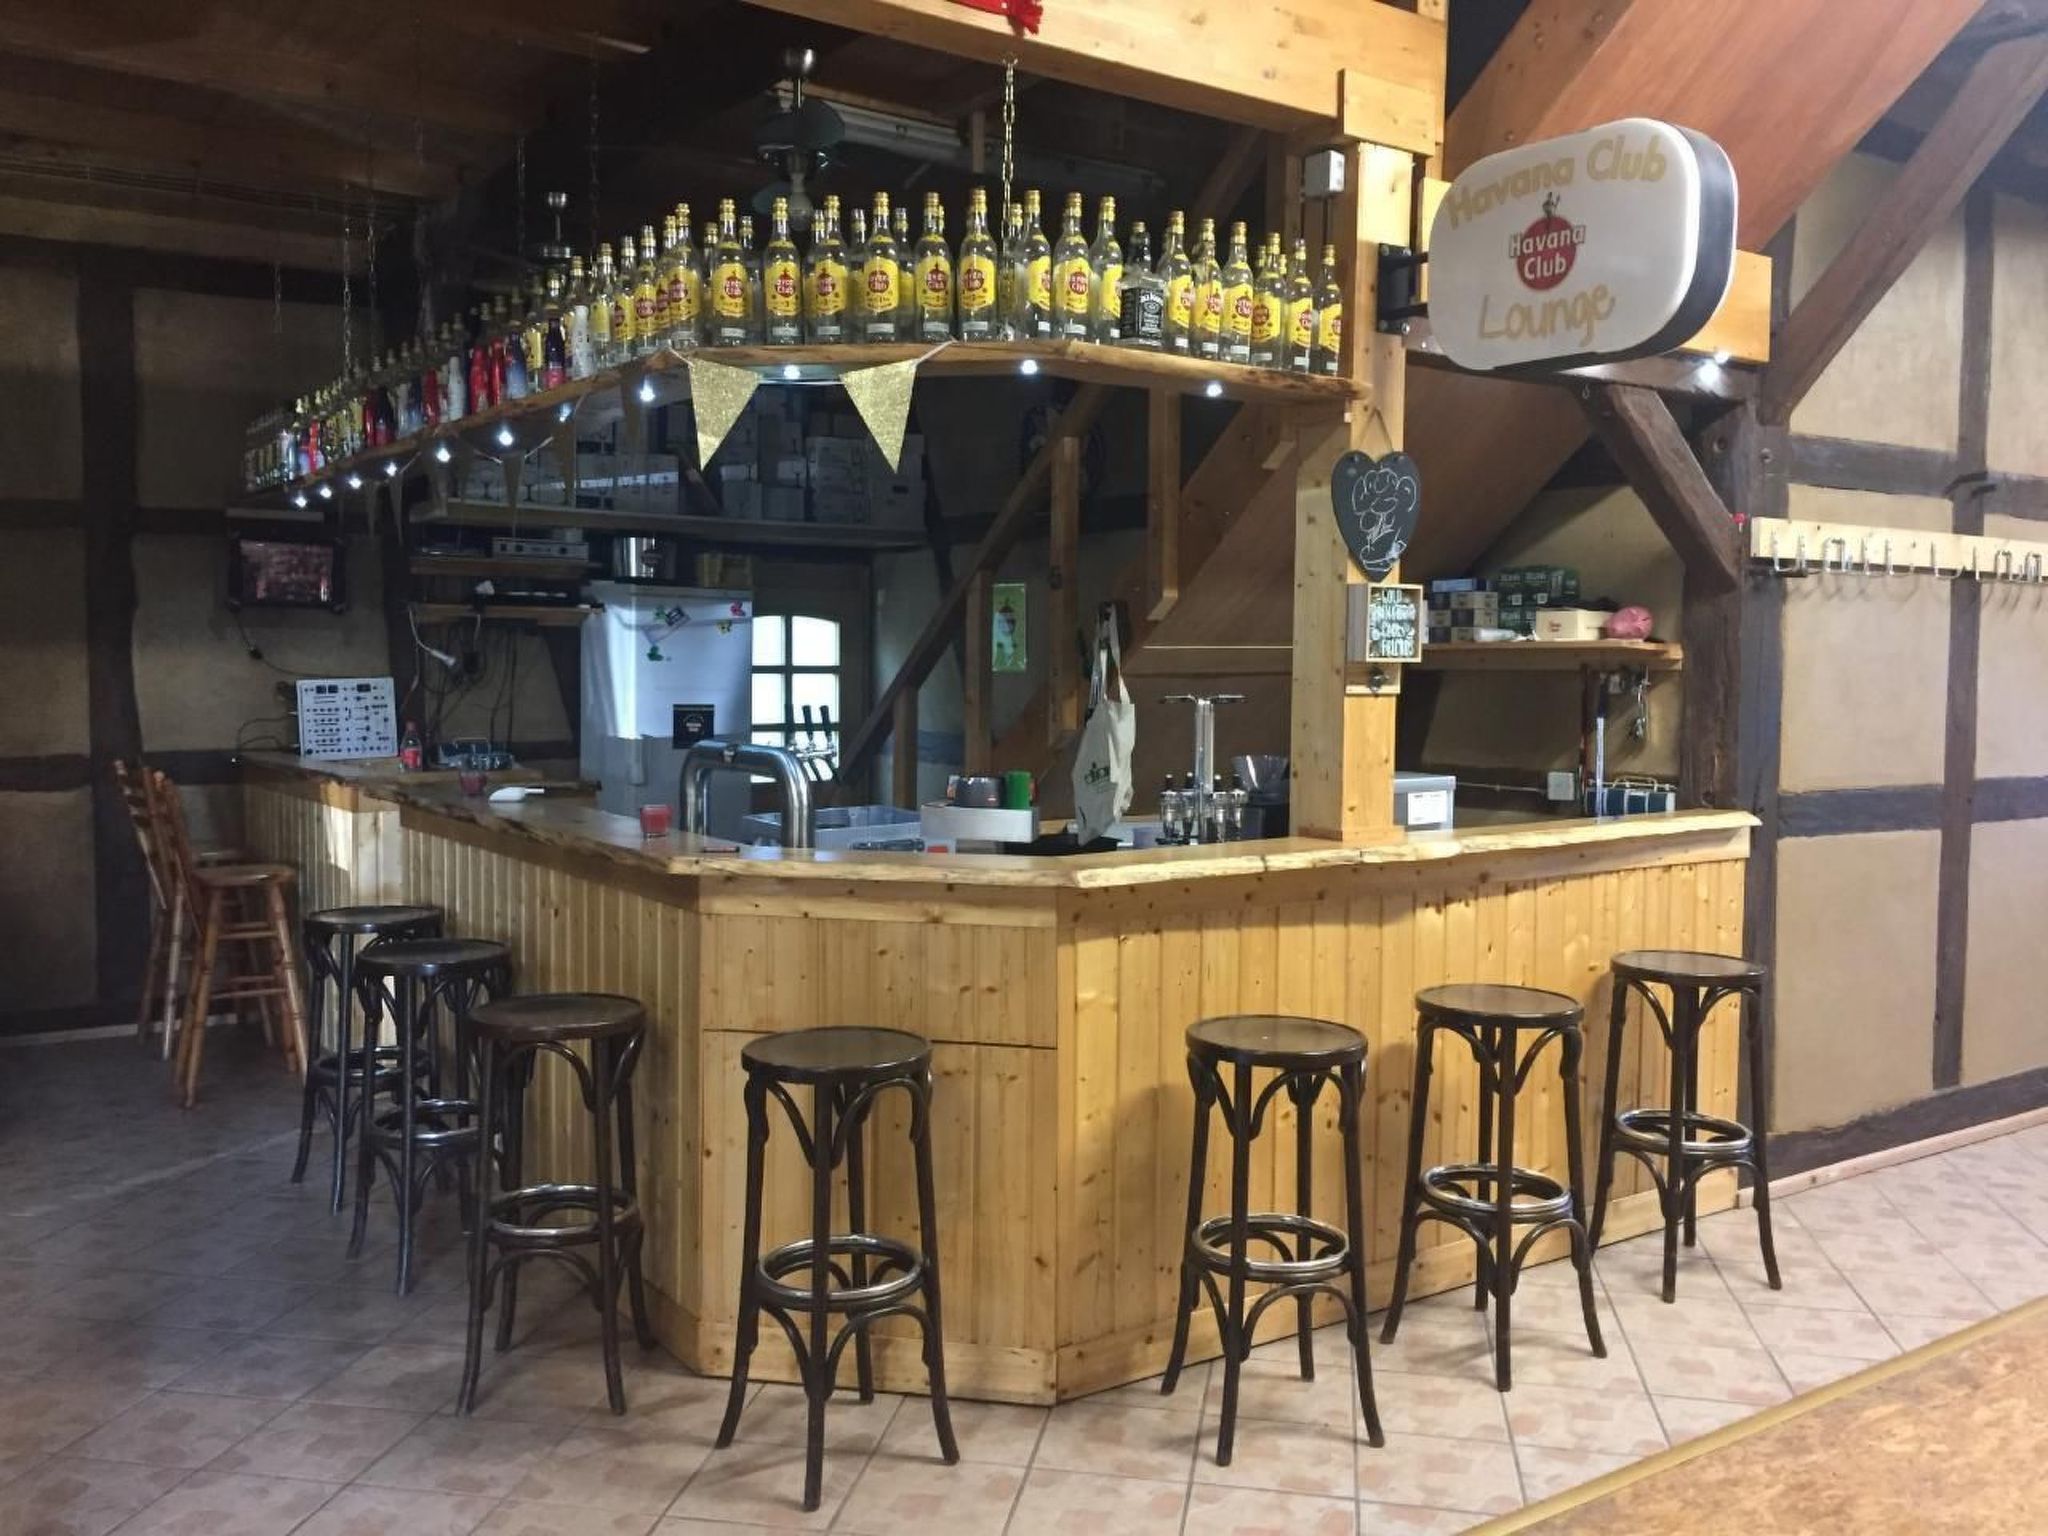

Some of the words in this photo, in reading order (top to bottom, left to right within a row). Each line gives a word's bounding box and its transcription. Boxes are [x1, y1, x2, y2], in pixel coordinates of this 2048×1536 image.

[1447, 157, 1575, 229] Havana
[1587, 133, 1666, 182] Club
[1508, 225, 1586, 258] Havana
[1523, 252, 1567, 280] Club
[1479, 283, 1616, 347] Lounge
